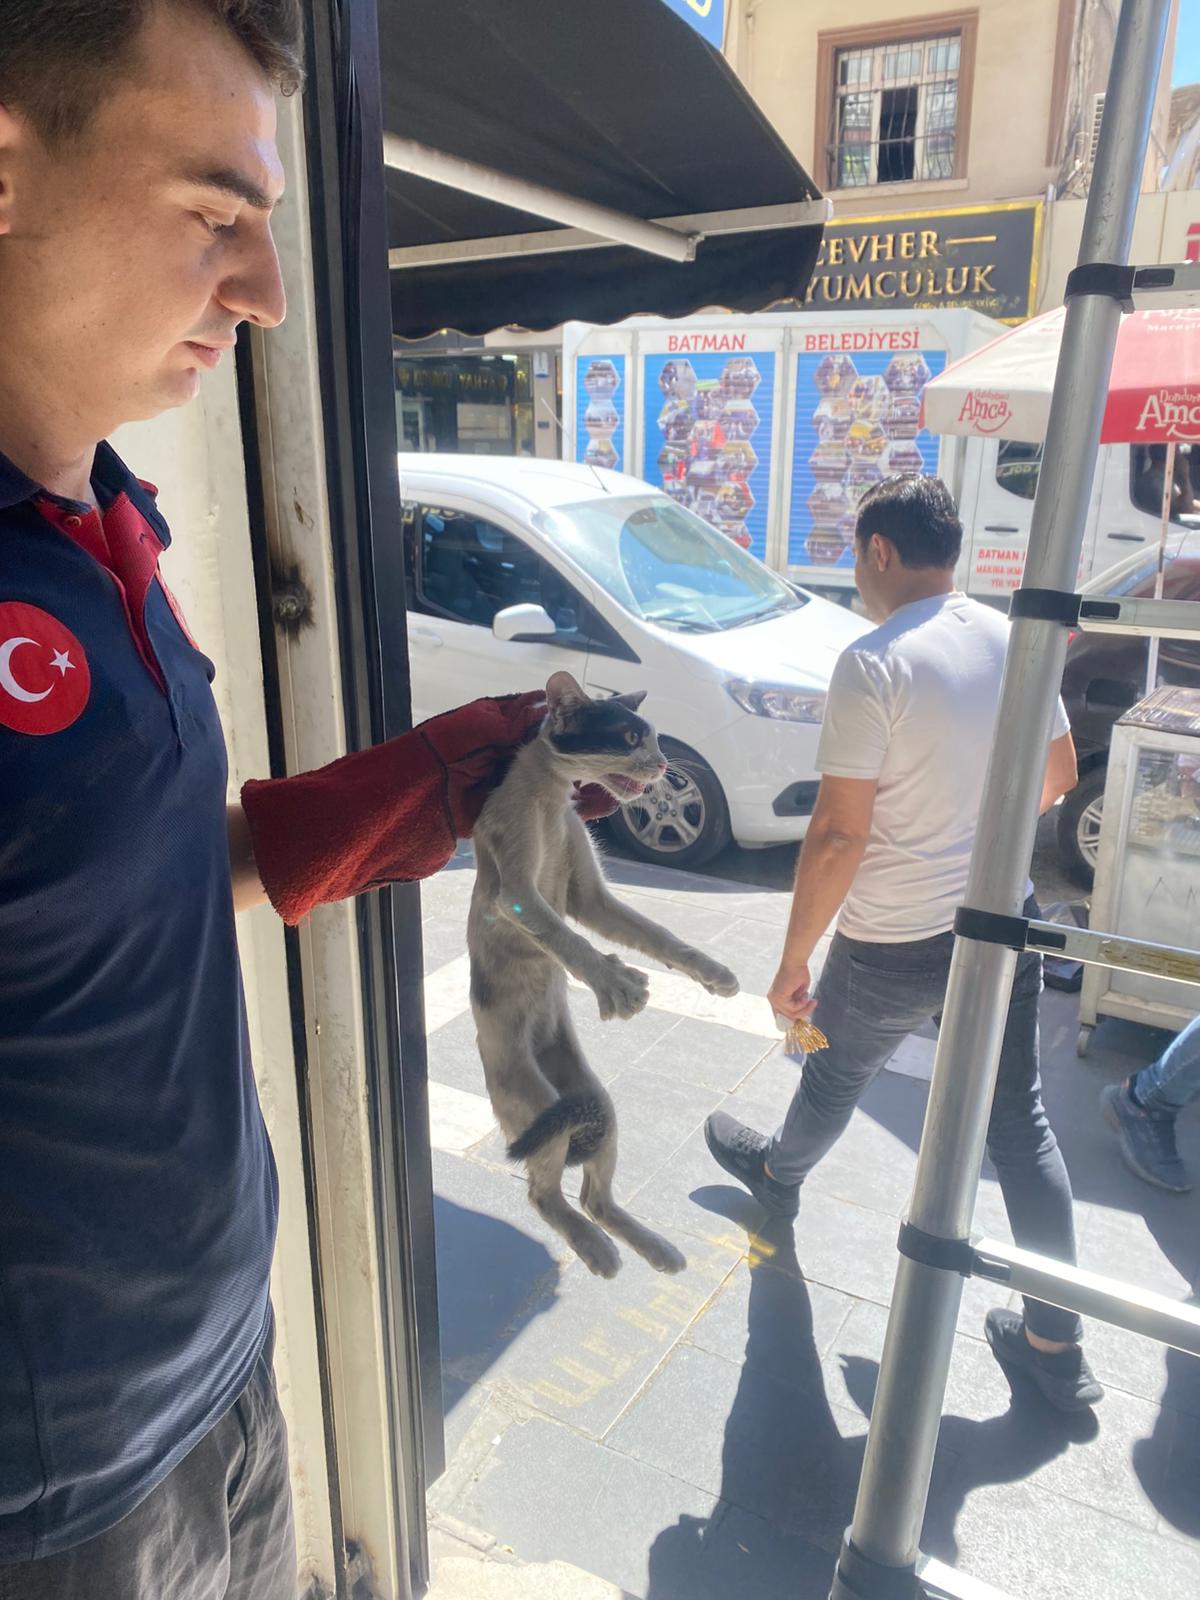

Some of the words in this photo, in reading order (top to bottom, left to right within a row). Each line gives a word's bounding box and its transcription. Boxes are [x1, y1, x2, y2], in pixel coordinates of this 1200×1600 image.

[668, 334, 747, 351] BATMAN
[805, 327, 920, 351] BELEDİYESİ
[958, 391, 1009, 422] Amca
[978, 548, 1019, 561] BATMAN
